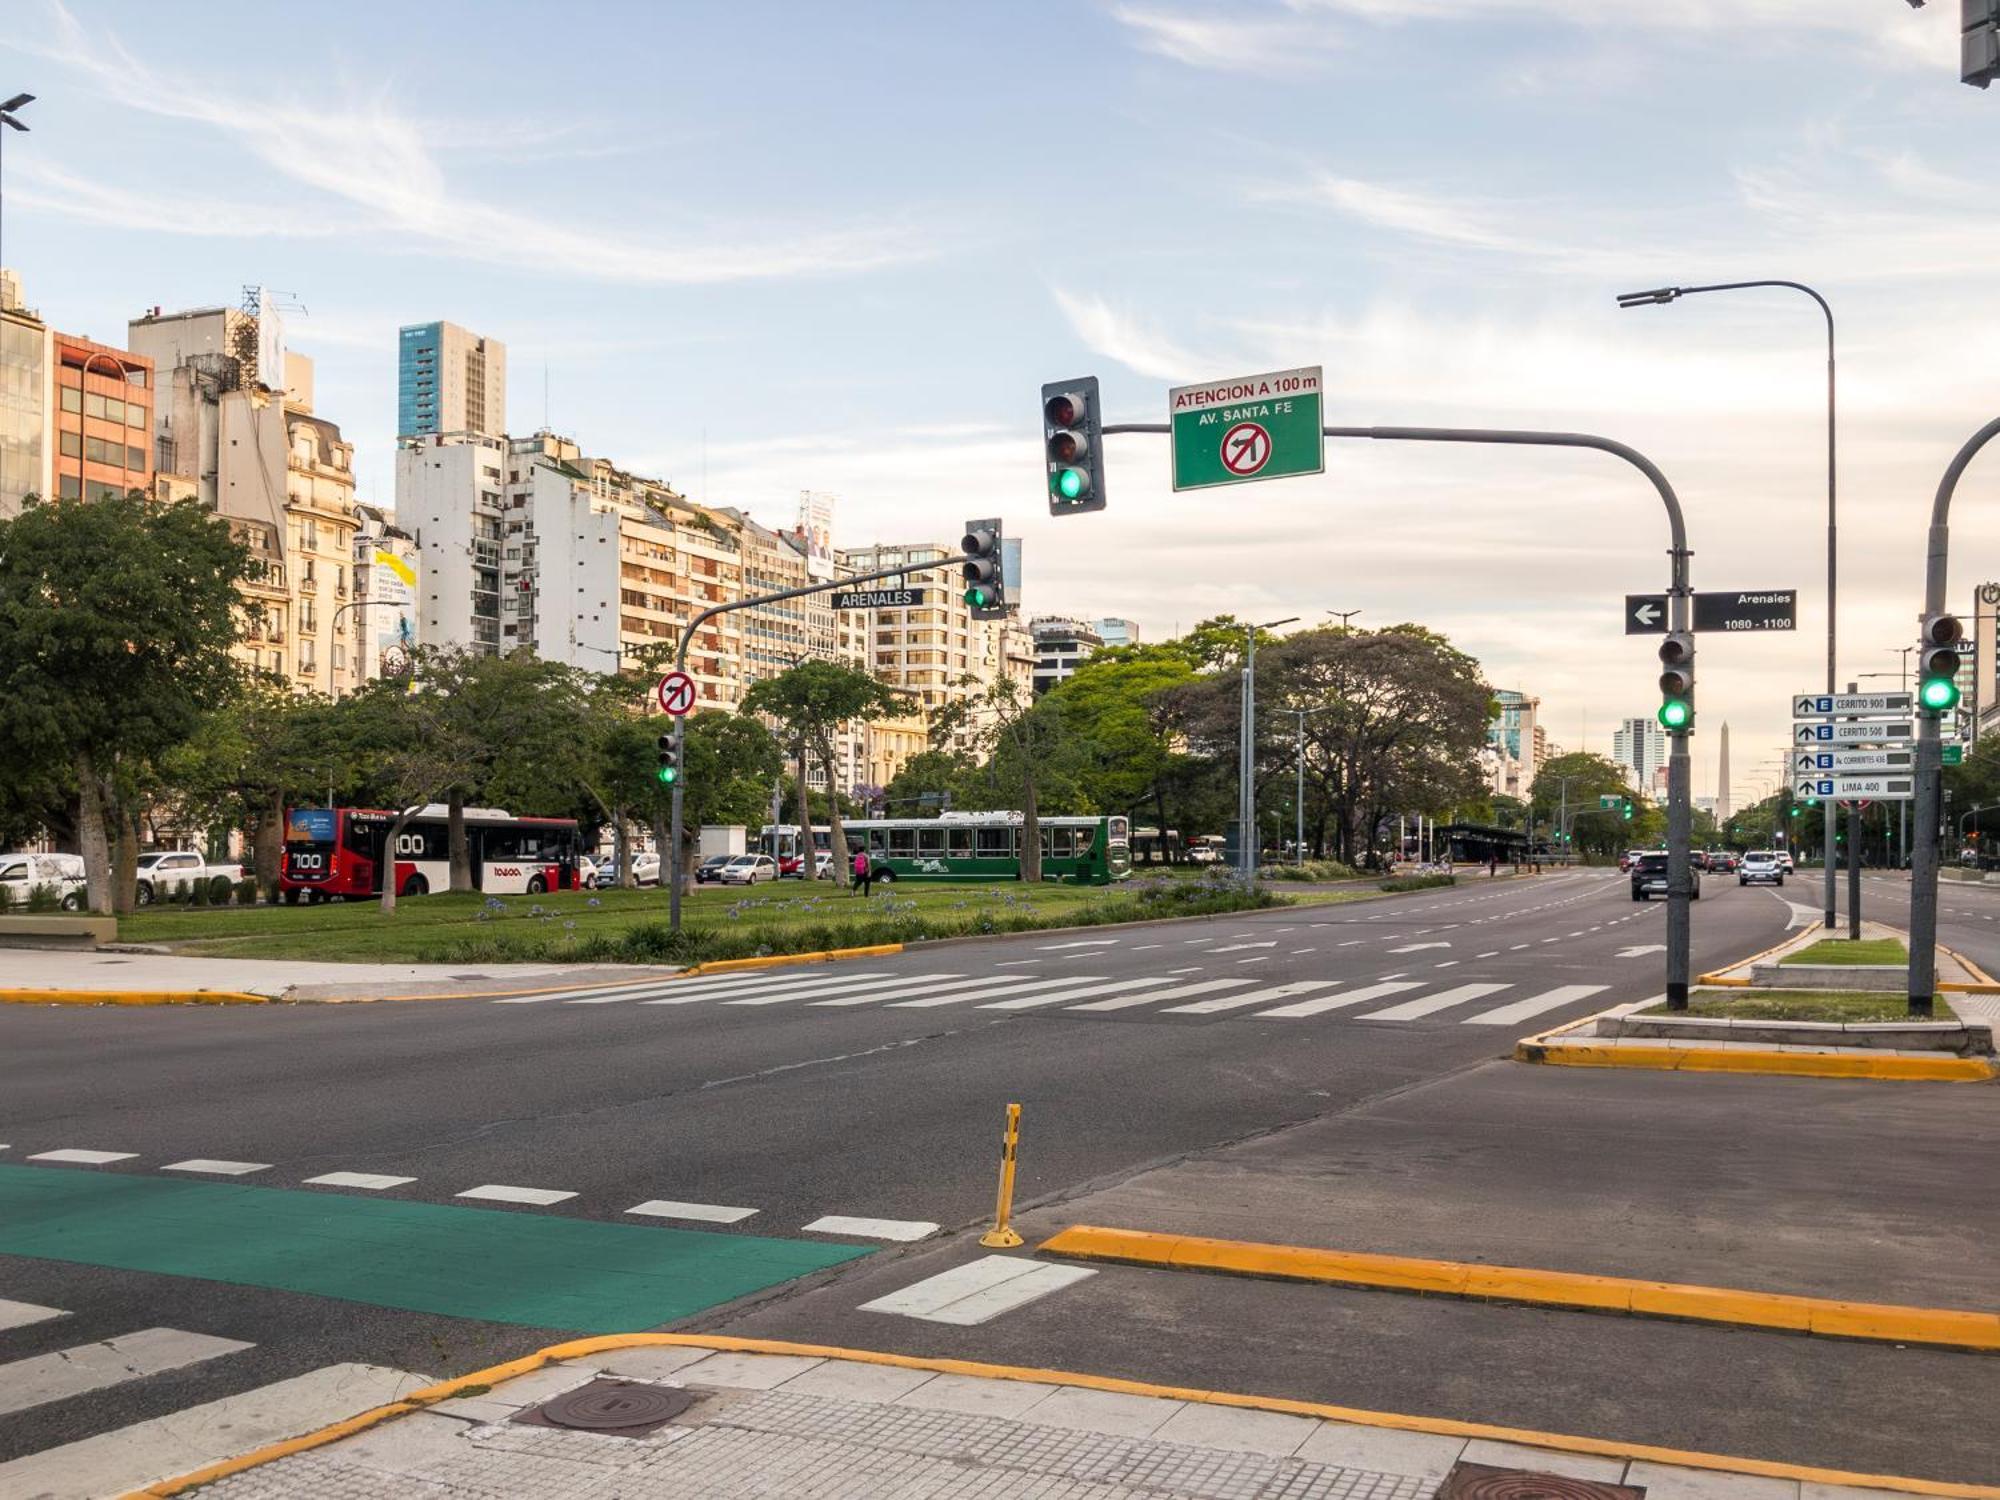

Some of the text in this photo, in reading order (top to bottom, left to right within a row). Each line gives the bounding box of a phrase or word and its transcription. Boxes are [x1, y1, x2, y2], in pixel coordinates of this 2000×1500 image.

[1175, 377, 1316, 408] ATENCION A 100 m
[1199, 402, 1293, 426] AV. SANTA FE
[840, 591, 912, 607] ARENALES
[1738, 594, 1791, 604] Arenales
[1725, 619, 1752, 630] 1080
[1764, 618, 1791, 629] 1100
[1836, 699, 1867, 709] CERRITO
[1839, 727, 1867, 737] CERRITO
[1842, 782, 1862, 792] LIMA
[1865, 782, 1880, 792] 400
